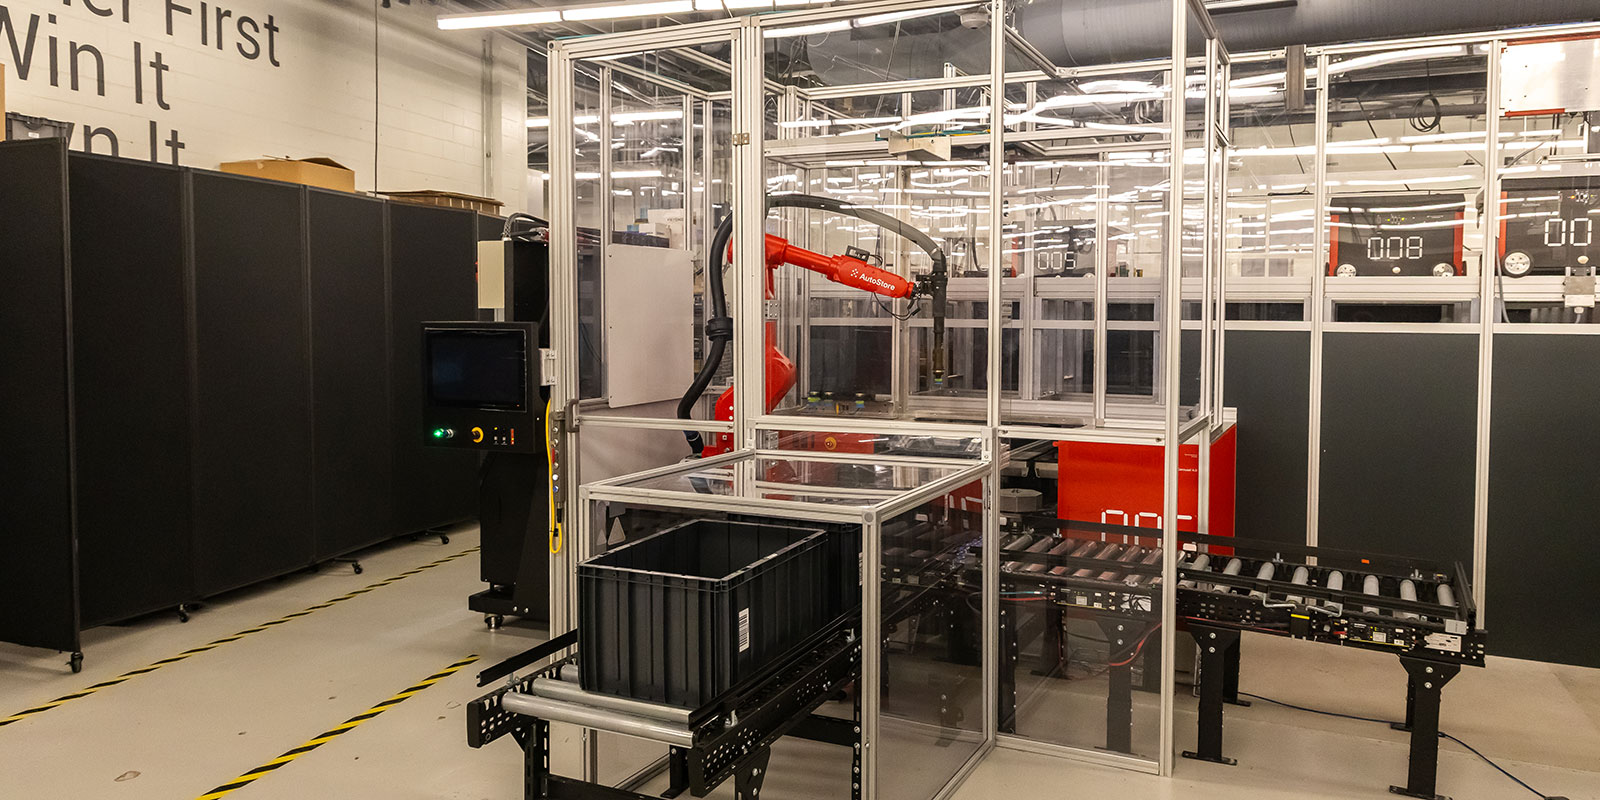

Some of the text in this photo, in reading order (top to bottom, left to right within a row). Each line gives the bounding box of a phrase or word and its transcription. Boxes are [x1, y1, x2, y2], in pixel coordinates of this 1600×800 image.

[134, 41, 171, 110] It
[1367, 236, 1423, 260] 008
[1037, 251, 1076, 270] 005
[859, 273, 895, 290] AutoStore
